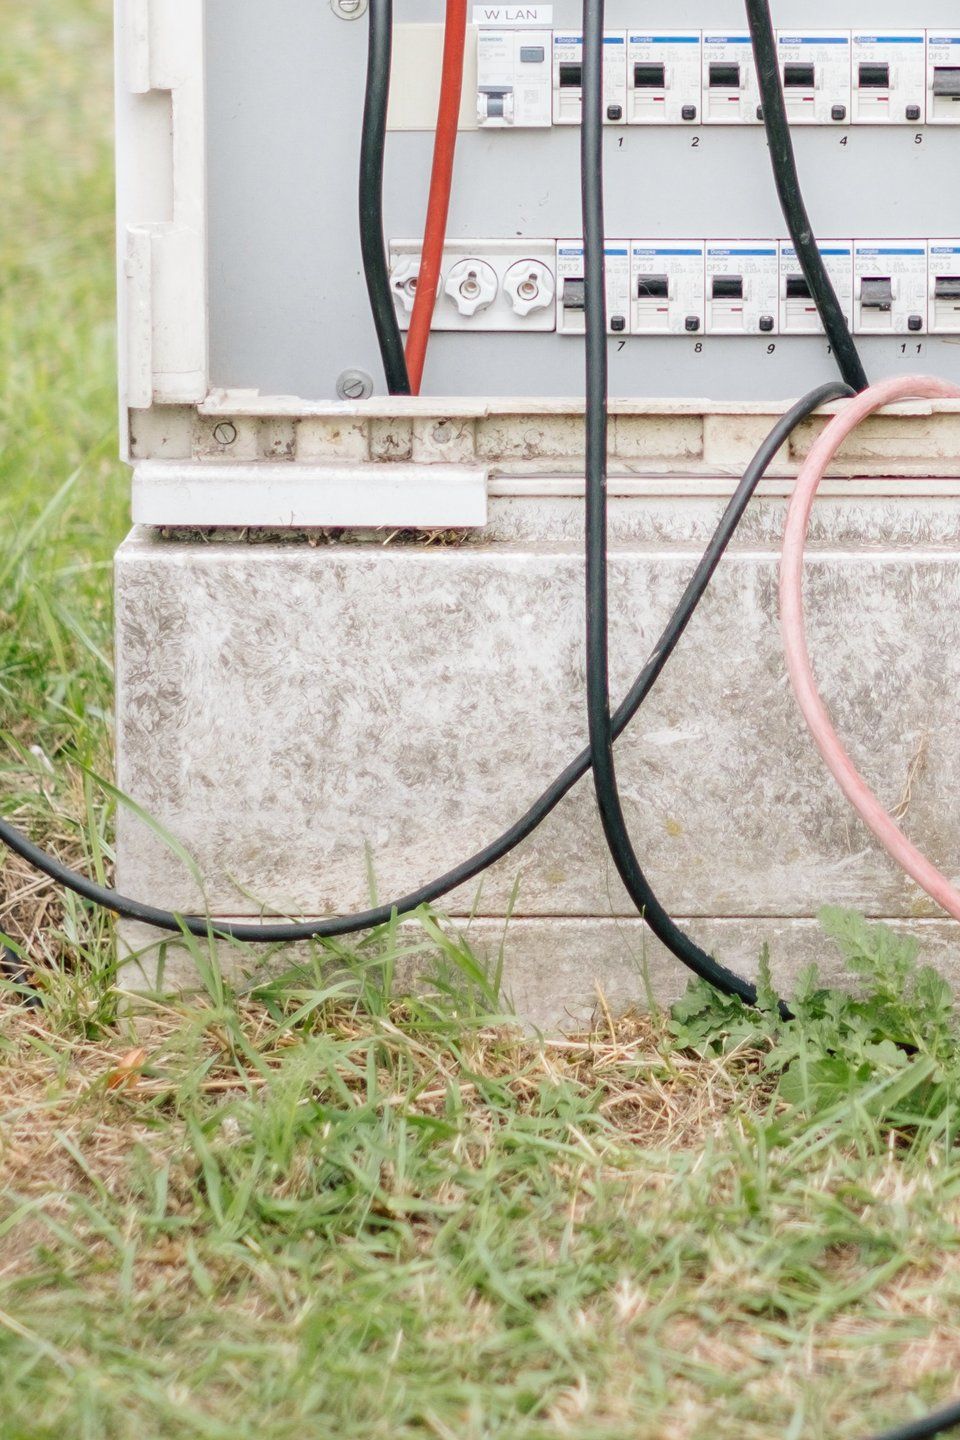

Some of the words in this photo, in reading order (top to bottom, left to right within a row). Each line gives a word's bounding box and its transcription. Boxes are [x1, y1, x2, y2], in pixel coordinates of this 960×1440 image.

[618, 138, 624, 147] 1
[692, 137, 700, 147] 2
[840, 136, 848, 146] 4
[915, 134, 922, 144] 5
[617, 341, 625, 352] 7
[694, 343, 702, 353] 8
[767, 344, 775, 354] 9
[900, 343, 922, 354] 11
